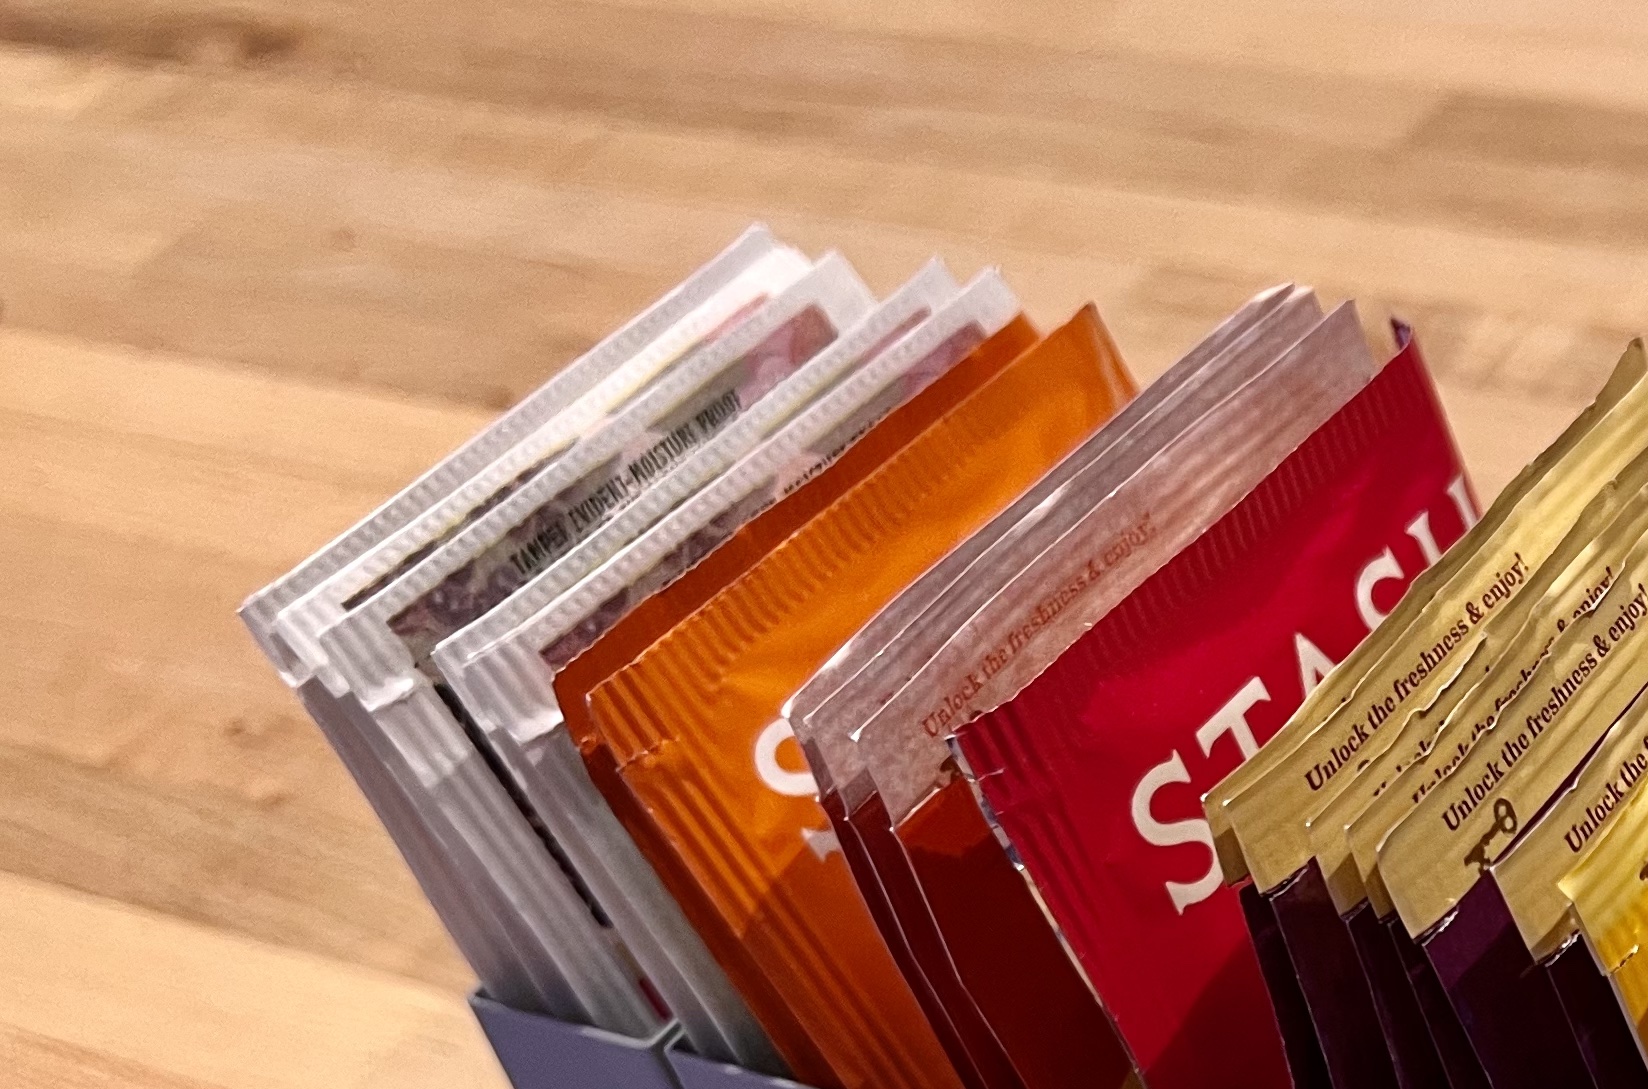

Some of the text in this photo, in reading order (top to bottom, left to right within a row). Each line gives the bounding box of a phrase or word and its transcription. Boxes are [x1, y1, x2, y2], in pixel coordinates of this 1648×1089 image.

[922, 674, 982, 738] Unlock
[982, 643, 1009, 680] the
[1007, 573, 1087, 654] freshness
[1304, 724, 1370, 792] Unlock
[1368, 697, 1396, 730] the
[1393, 619, 1470, 703] freshness
[1465, 601, 1485, 625] &
[1482, 552, 1530, 610] enjoy!
[1441, 762, 1505, 832] Unlock
[1502, 731, 1530, 768] the
[1526, 652, 1598, 738] freshness
[1593, 634, 1611, 658] &
[1564, 780, 1625, 854] Unlock
[1619, 751, 1648, 788] the
